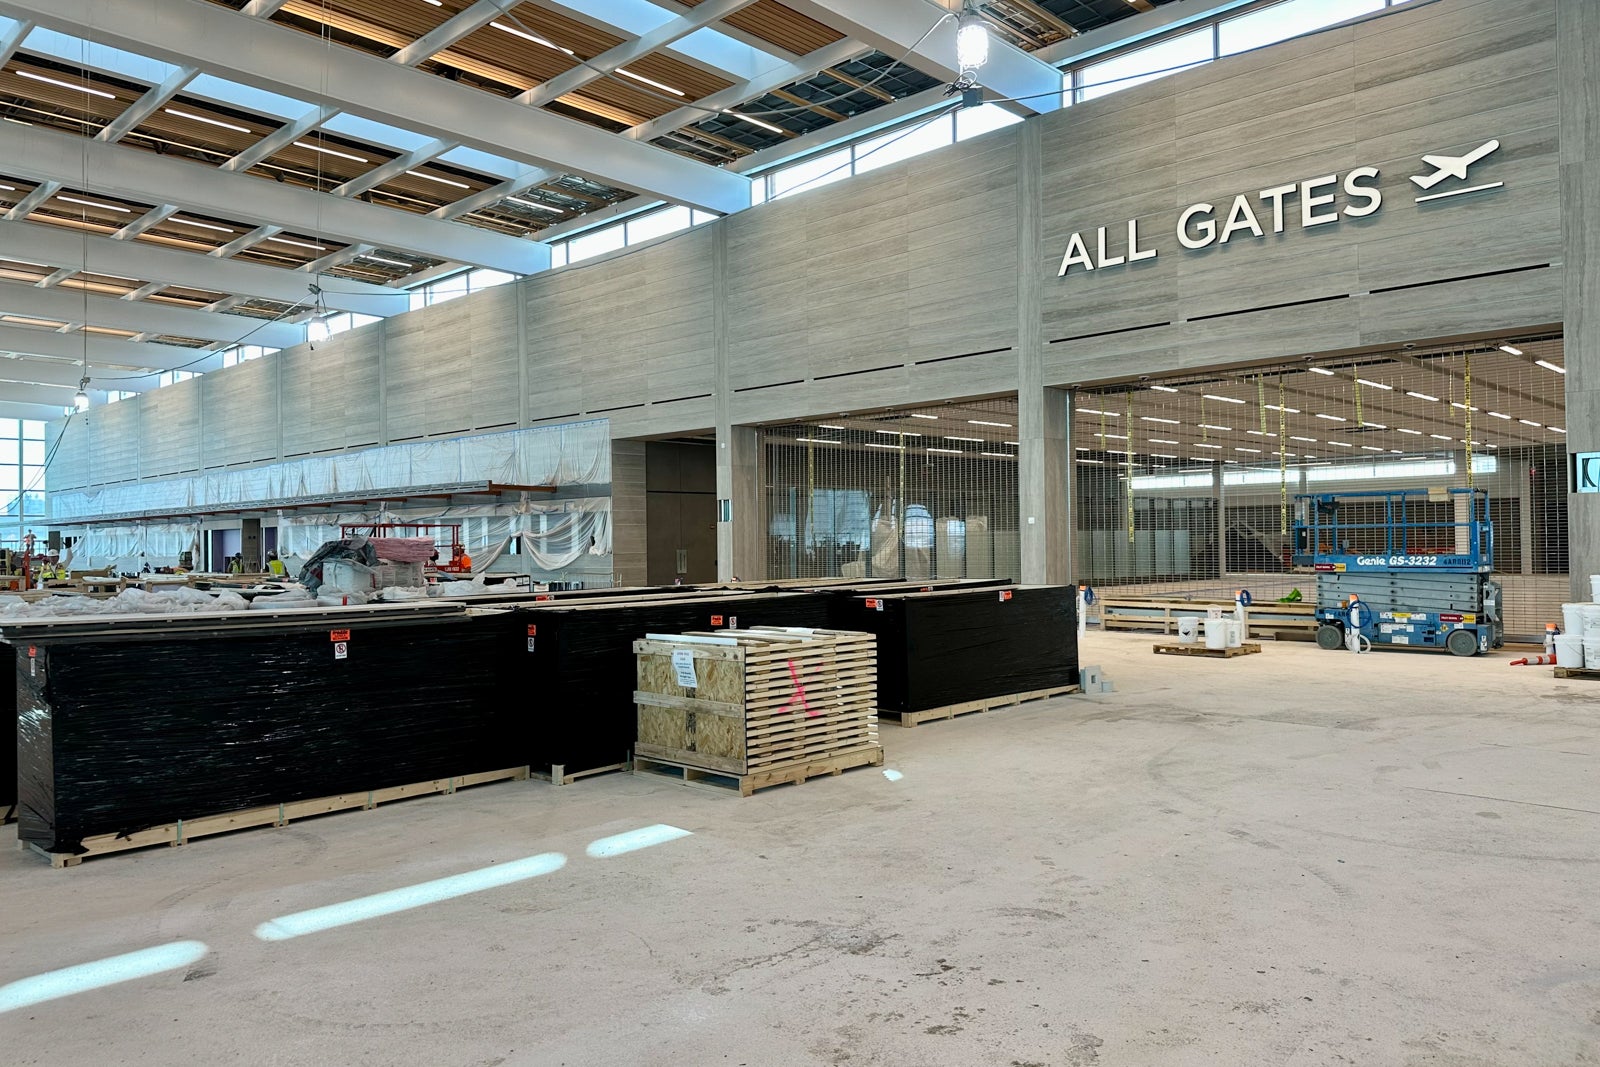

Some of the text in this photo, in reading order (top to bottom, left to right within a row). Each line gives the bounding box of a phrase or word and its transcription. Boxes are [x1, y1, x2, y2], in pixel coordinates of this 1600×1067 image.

[1057, 166, 1383, 278] ALL GATES
[1356, 556, 1438, 566] Genie GS-3232
